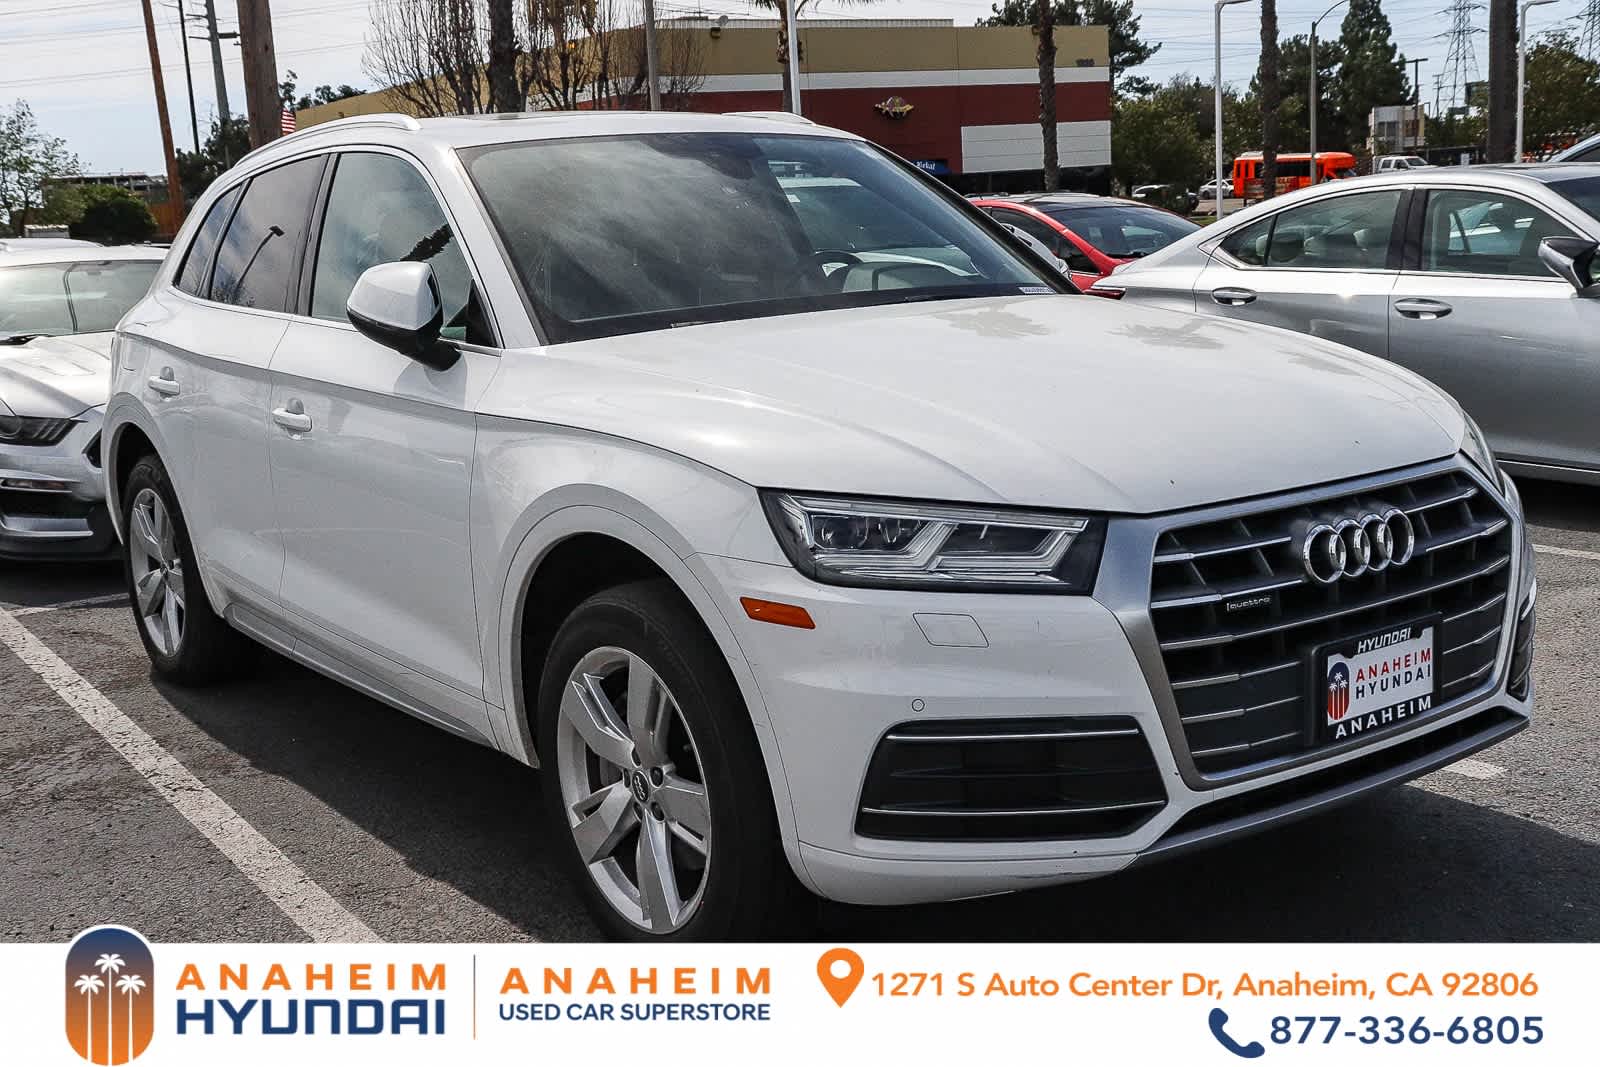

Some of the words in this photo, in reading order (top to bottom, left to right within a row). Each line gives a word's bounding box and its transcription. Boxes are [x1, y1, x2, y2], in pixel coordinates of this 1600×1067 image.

[1229, 596, 1271, 611] quattro
[1357, 627, 1412, 654] HYUNDAI
[1355, 648, 1431, 683] ANAHEIM
[1355, 665, 1431, 699] HYUNDAI
[1335, 695, 1432, 739] ANAHEIM
